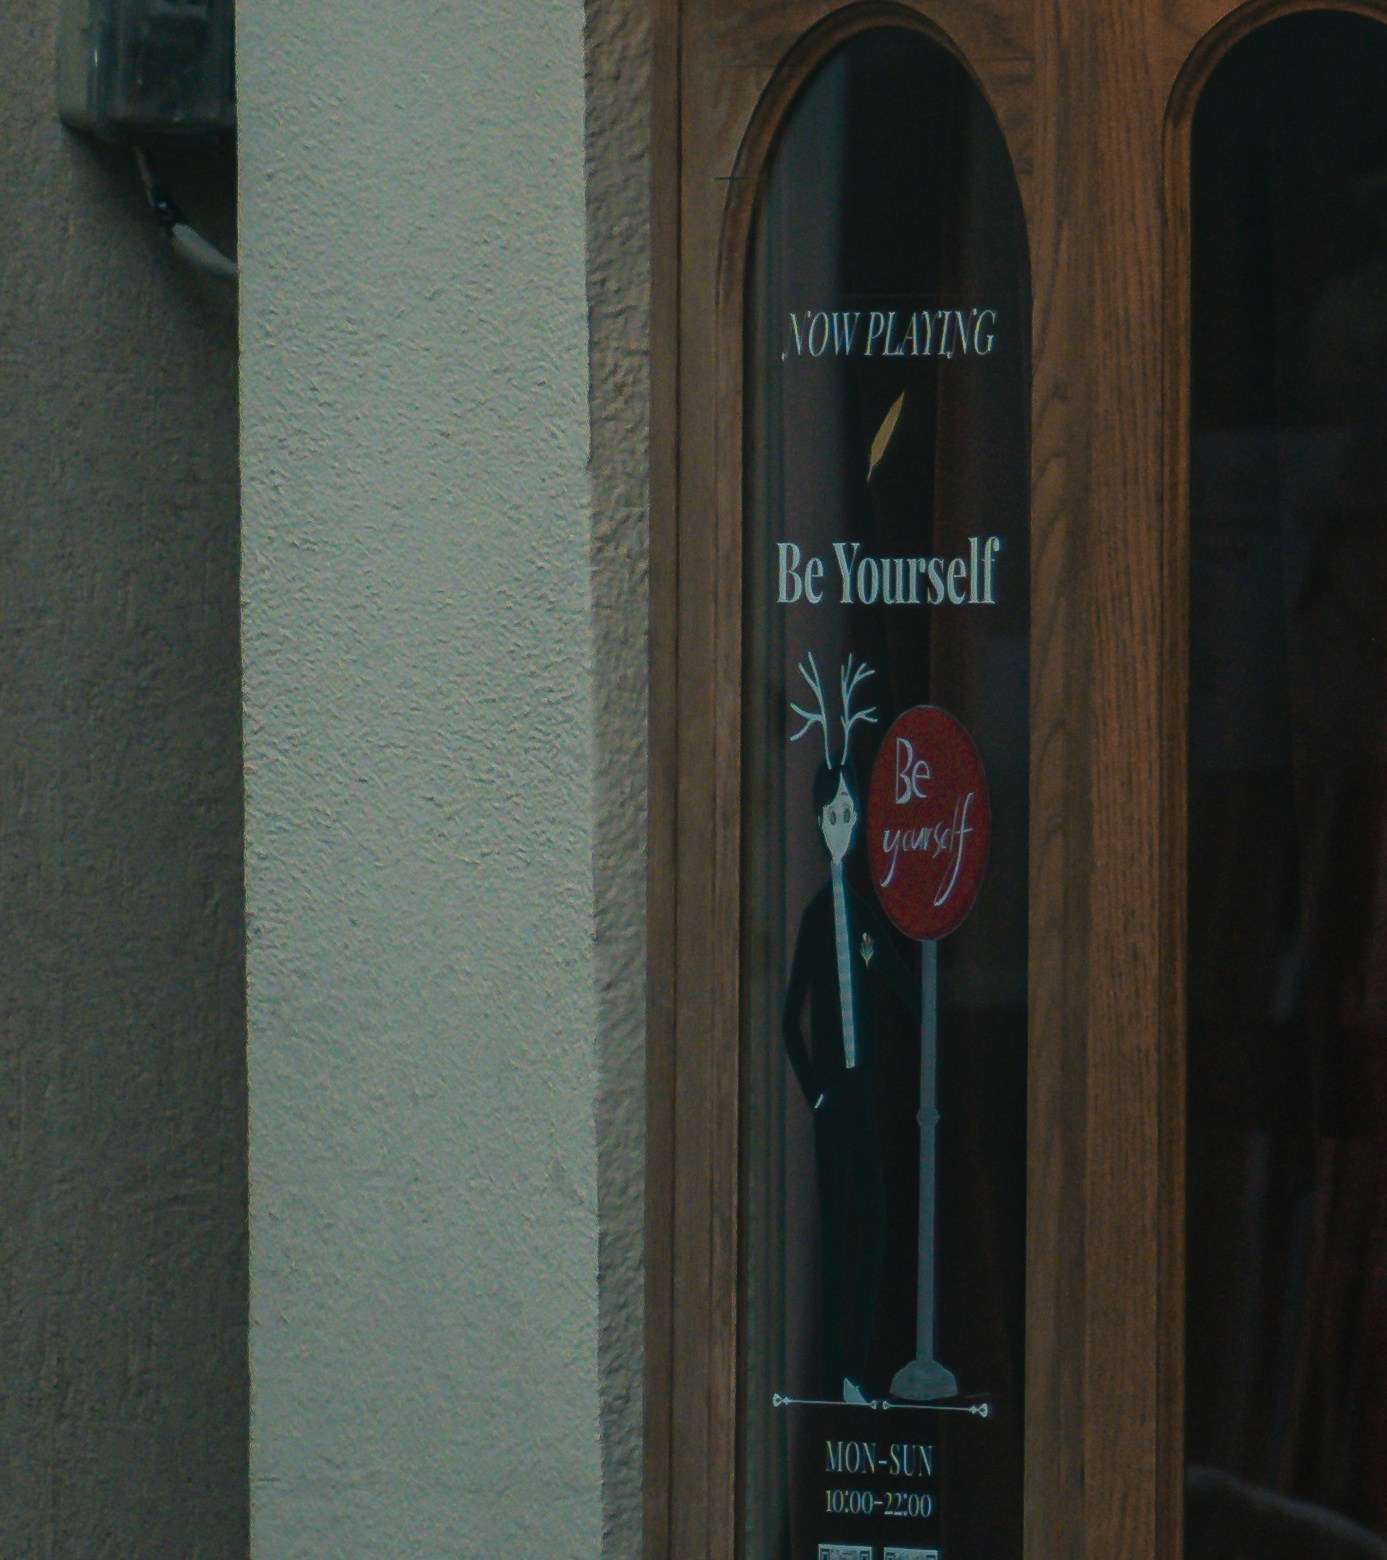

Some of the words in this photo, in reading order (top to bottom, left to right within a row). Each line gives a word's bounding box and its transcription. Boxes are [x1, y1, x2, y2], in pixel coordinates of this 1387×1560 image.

[782, 312, 860, 360] NOW
[865, 309, 997, 359] PLAYING
[777, 542, 823, 605] Be
[835, 536, 1000, 606] Yourself
[895, 737, 930, 805] Be
[824, 1439, 934, 1478] MON-SUN
[824, 1489, 933, 1520] 10:00-22:00
